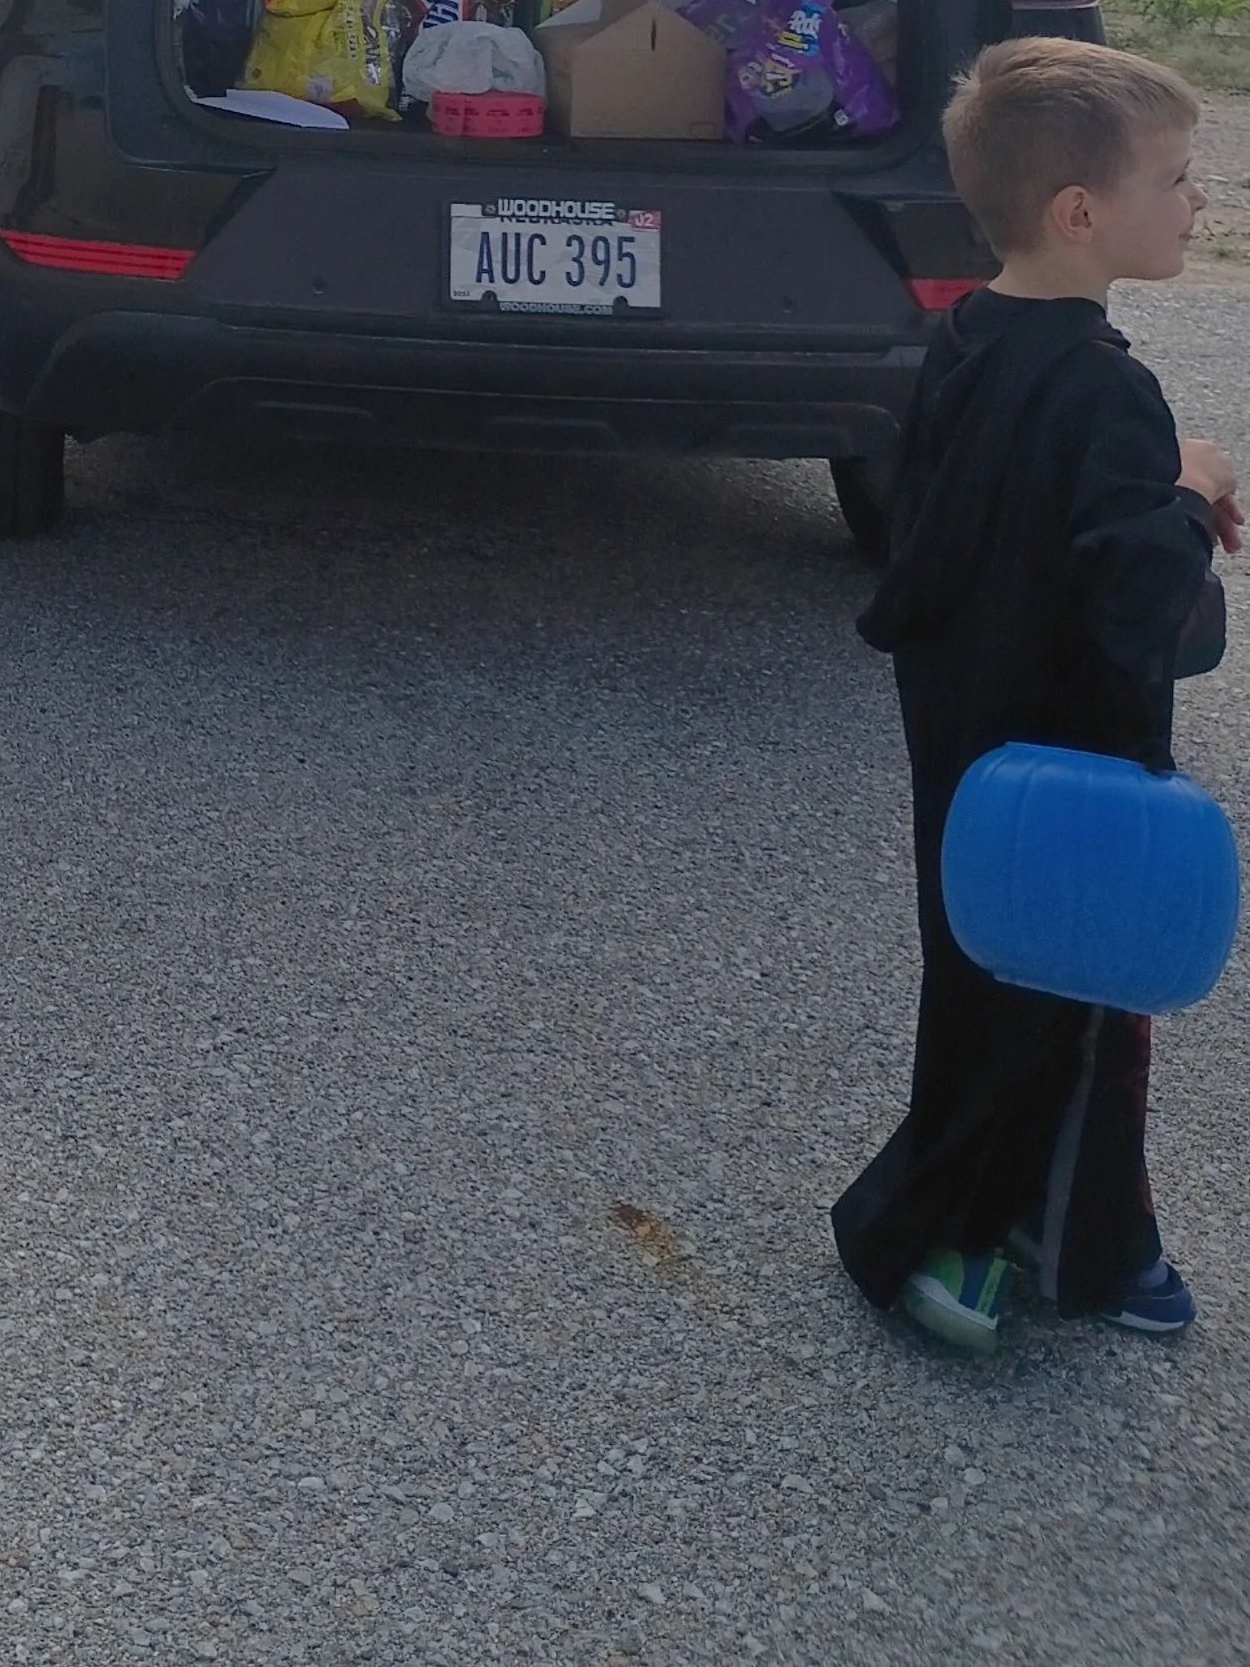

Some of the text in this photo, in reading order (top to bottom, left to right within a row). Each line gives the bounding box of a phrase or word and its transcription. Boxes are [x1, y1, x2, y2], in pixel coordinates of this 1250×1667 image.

[498, 198, 615, 220] WOODHOUSE
[475, 231, 637, 289] AUC 395
